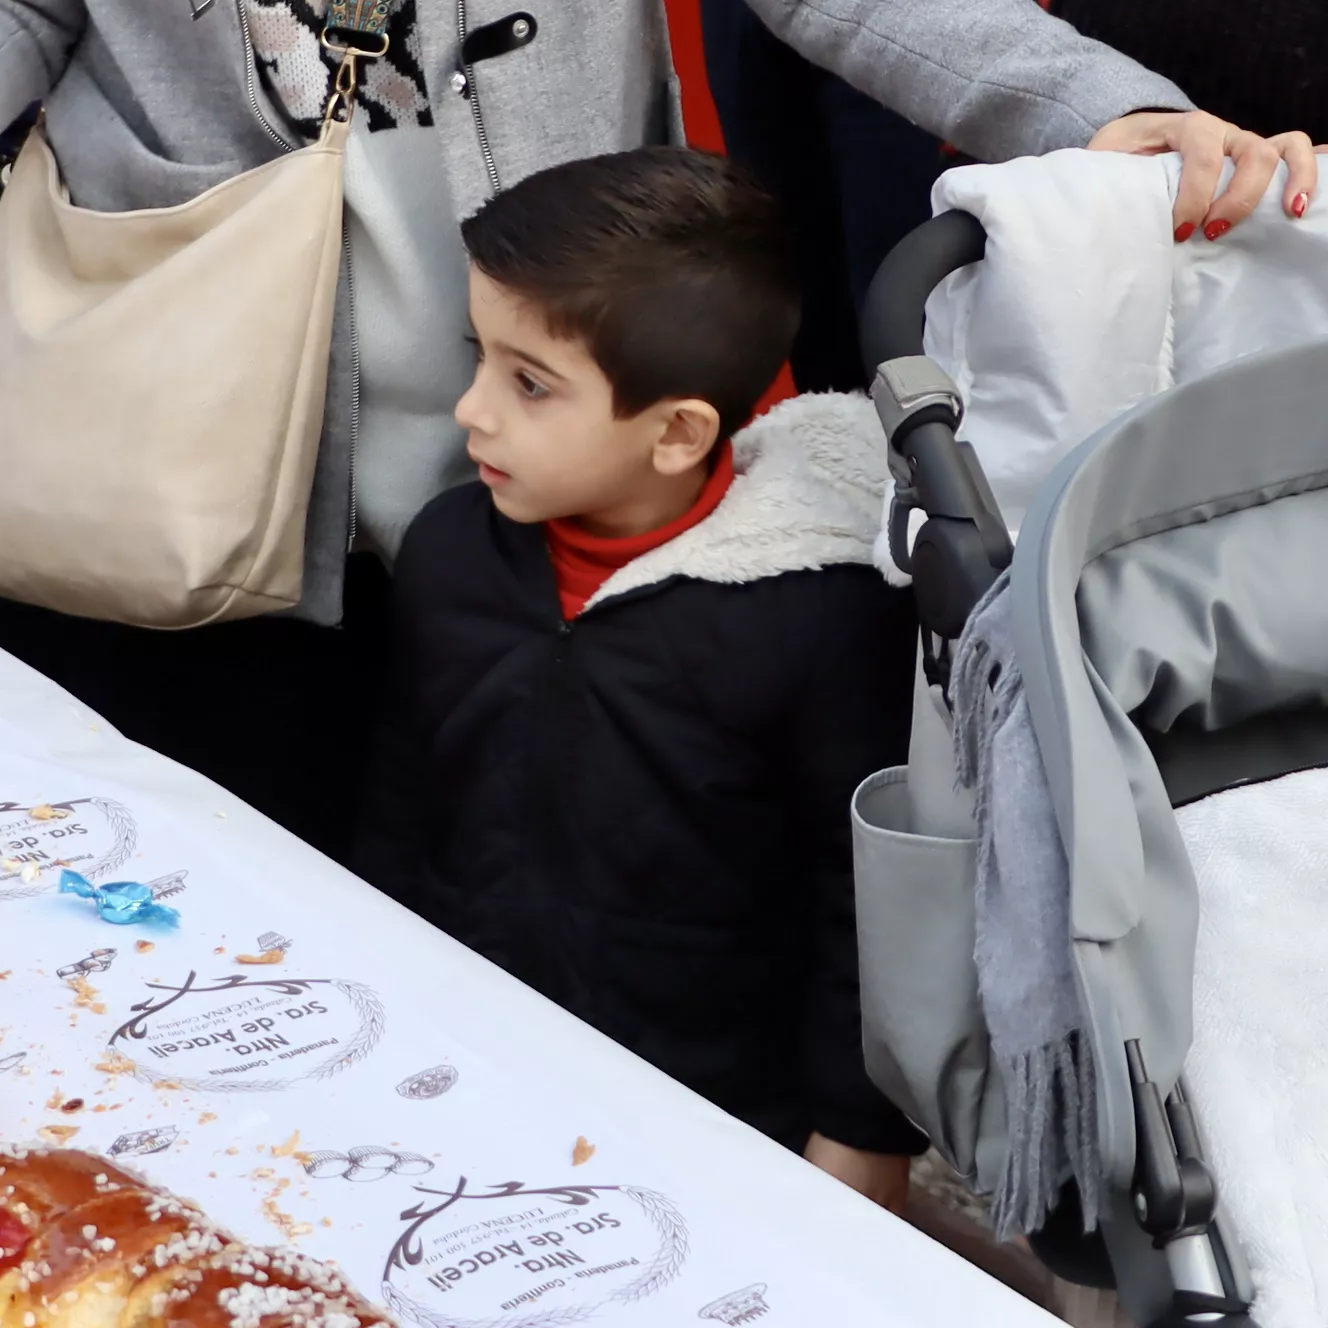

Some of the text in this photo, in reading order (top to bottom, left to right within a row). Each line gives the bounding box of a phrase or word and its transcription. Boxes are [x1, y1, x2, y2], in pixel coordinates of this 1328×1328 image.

[9, 836, 39, 850] de
[42, 823, 88, 839] Sra.
[201, 996, 261, 1020] LUCENA
[147, 1000, 329, 1060] Sra. de Araceli
[224, 1032, 291, 1059] Ntra.
[431, 1207, 544, 1246] LUCENA Córdoba
[520, 1222, 533, 1230] 14
[422, 1252, 444, 1265] 101
[426, 1212, 622, 1293] Sra. de Araceli
[446, 1242, 467, 1254] 500
[513, 1248, 586, 1277] Ntra.
